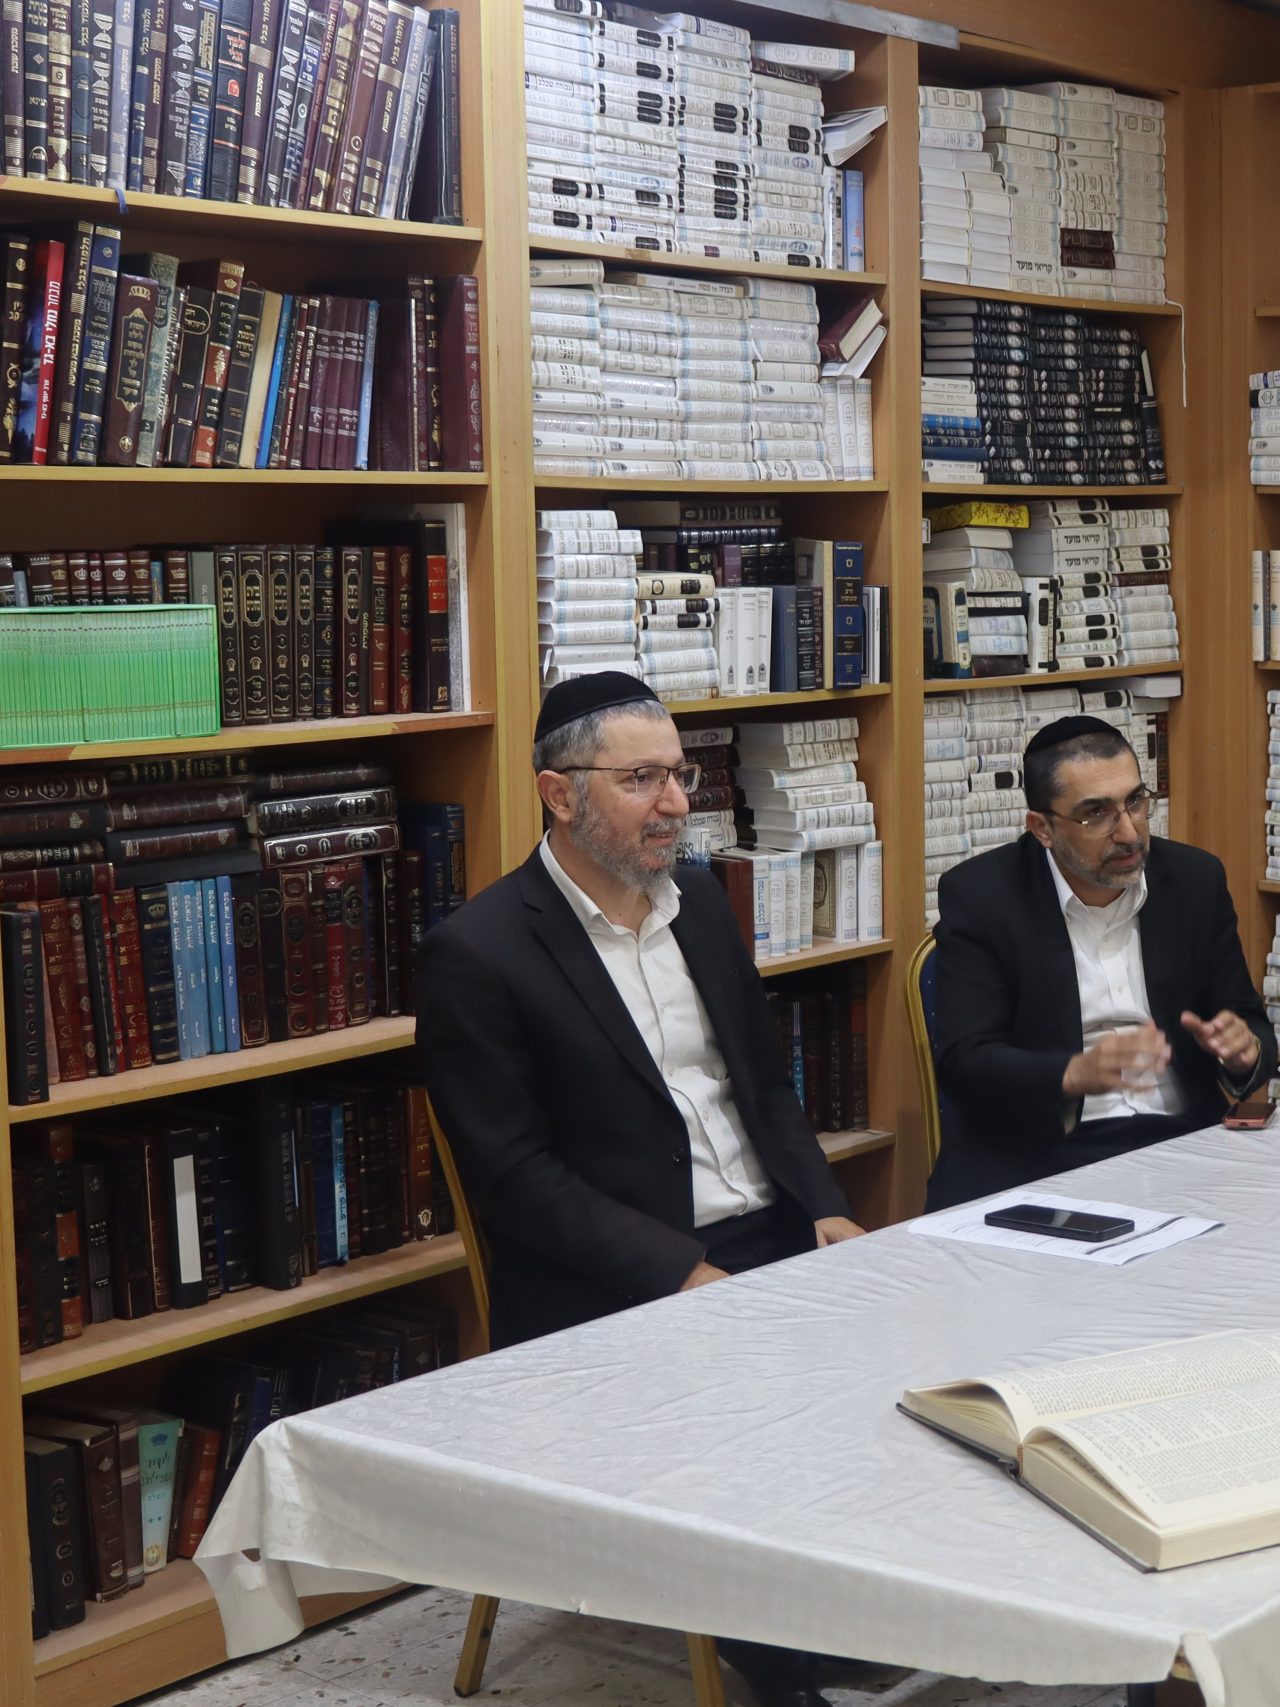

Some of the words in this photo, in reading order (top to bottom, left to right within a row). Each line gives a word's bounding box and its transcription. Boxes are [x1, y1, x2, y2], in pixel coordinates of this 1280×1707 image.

[394, 19, 404, 45] תלמוד
[256, 72, 264, 95] מסכת
[385, 91, 393, 111] מסכת
[80, 237, 90, 266] תלמוד
[1016, 260, 1033, 269] מועד
[1035, 264, 1052, 274] קריאי
[77, 269, 86, 290] בבלי
[48, 281, 60, 306] מבחר
[45, 309, 57, 331] נחלי
[73, 319, 81, 342] מסכת
[43, 335, 56, 365] בא-גד
[71, 344, 79, 356] בבא
[68, 357, 77, 386] מציעא
[1064, 535, 1080, 544] מועד
[1082, 534, 1100, 543] קריאי
[1065, 558, 1081, 566] מועד
[1083, 557, 1099, 566] קריאי
[693, 816, 706, 825] שבלב
[707, 814, 719, 824] עבודה
[172, 896, 180, 923] מקראות
